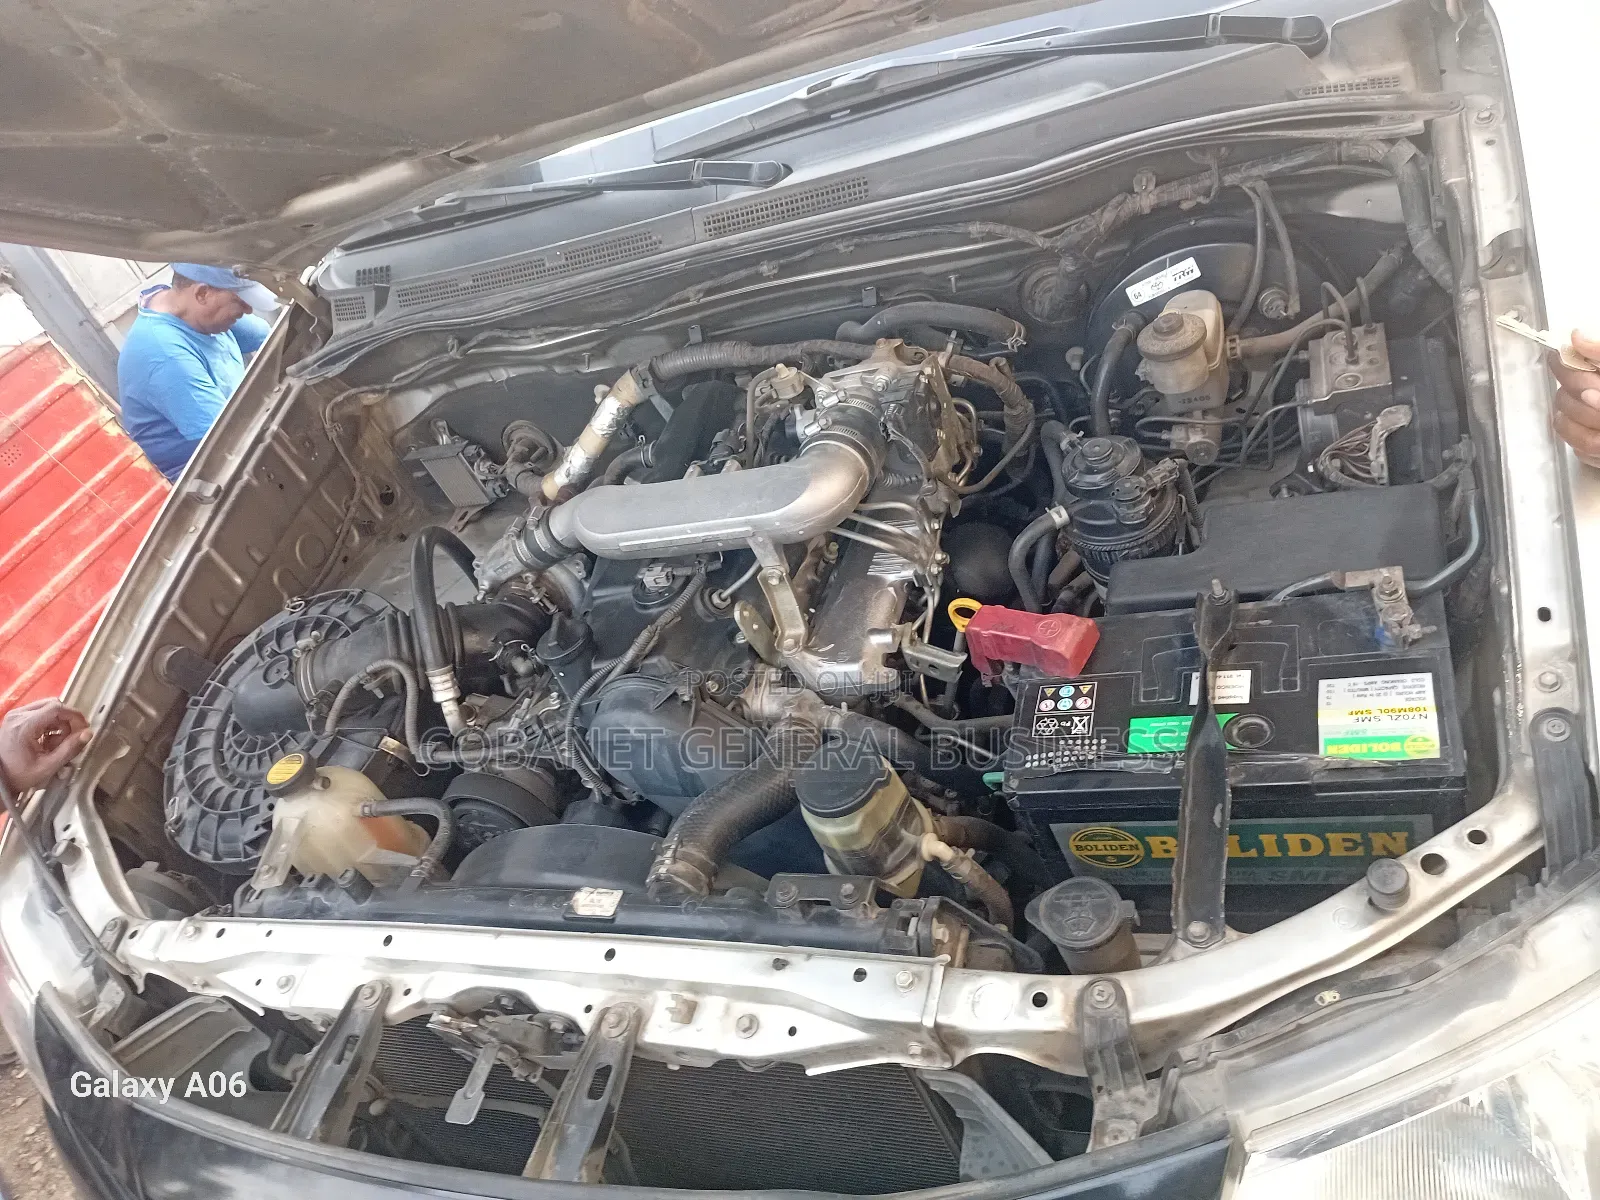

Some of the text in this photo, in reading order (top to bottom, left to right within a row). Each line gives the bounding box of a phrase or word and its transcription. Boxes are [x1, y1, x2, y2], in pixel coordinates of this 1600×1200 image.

[1172, 265, 1195, 282] TRW
[1347, 706, 1428, 716] 108M90L SMF
[1352, 713, 1428, 723] N70ZL SMF
[1327, 741, 1402, 755] BOLIDEN
[1073, 843, 1140, 852] BOLIDEN
[1145, 831, 1410, 860] BLIDEN
